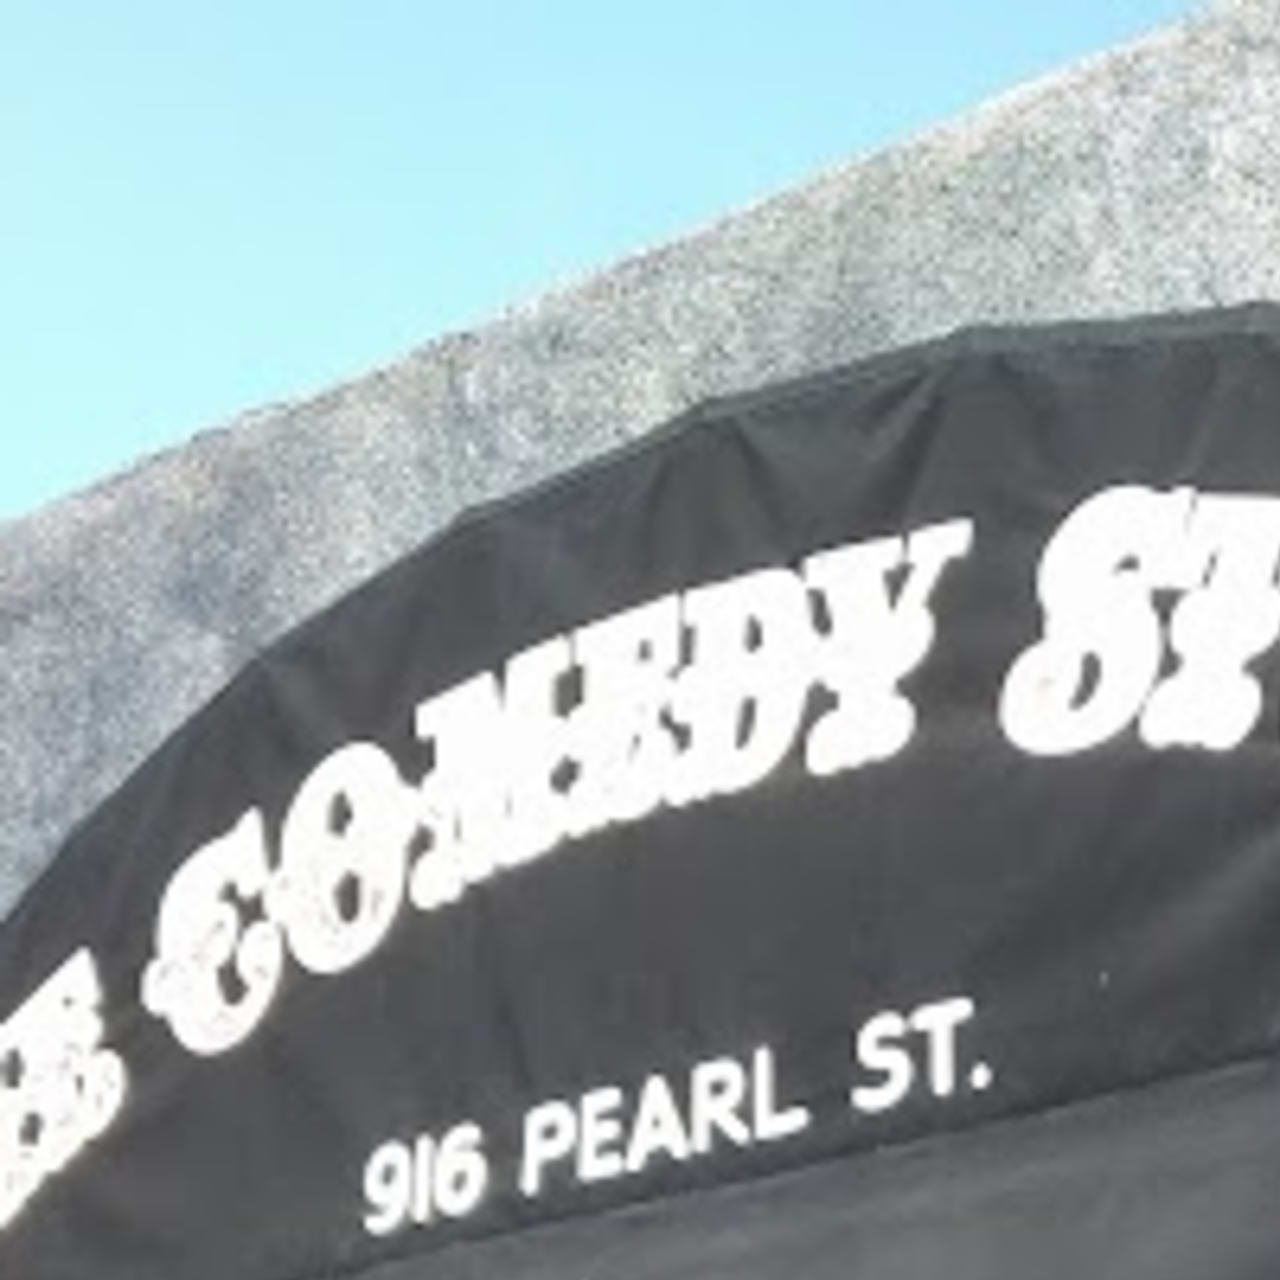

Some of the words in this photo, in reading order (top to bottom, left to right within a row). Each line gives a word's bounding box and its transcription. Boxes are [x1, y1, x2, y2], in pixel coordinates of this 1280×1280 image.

[142, 519, 973, 1055] COMEDY
[364, 1122, 489, 1235] 916
[519, 1046, 810, 1196] PEARL
[852, 998, 991, 1112] ST.
